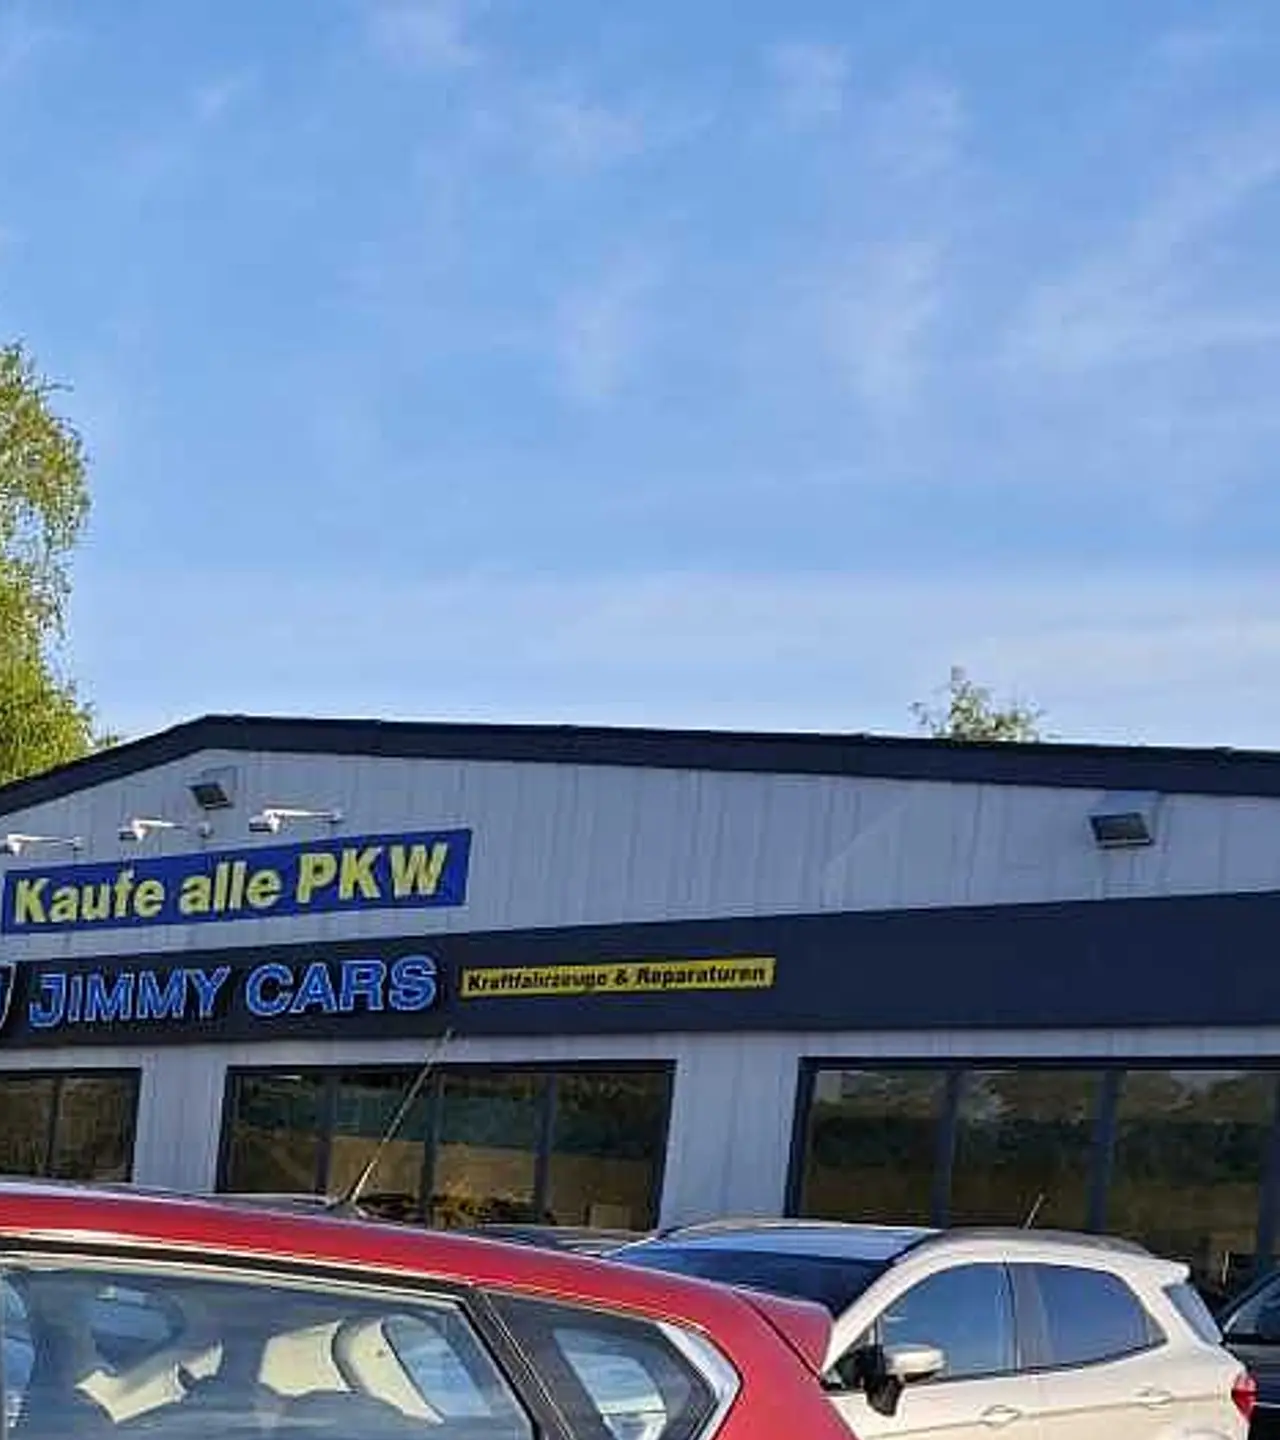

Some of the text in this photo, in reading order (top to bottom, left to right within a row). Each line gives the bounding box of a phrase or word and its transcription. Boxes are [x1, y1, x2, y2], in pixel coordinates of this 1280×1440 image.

[14, 842, 449, 924] Kaufe alle PKW
[29, 954, 437, 1028] JIMMY CARS
